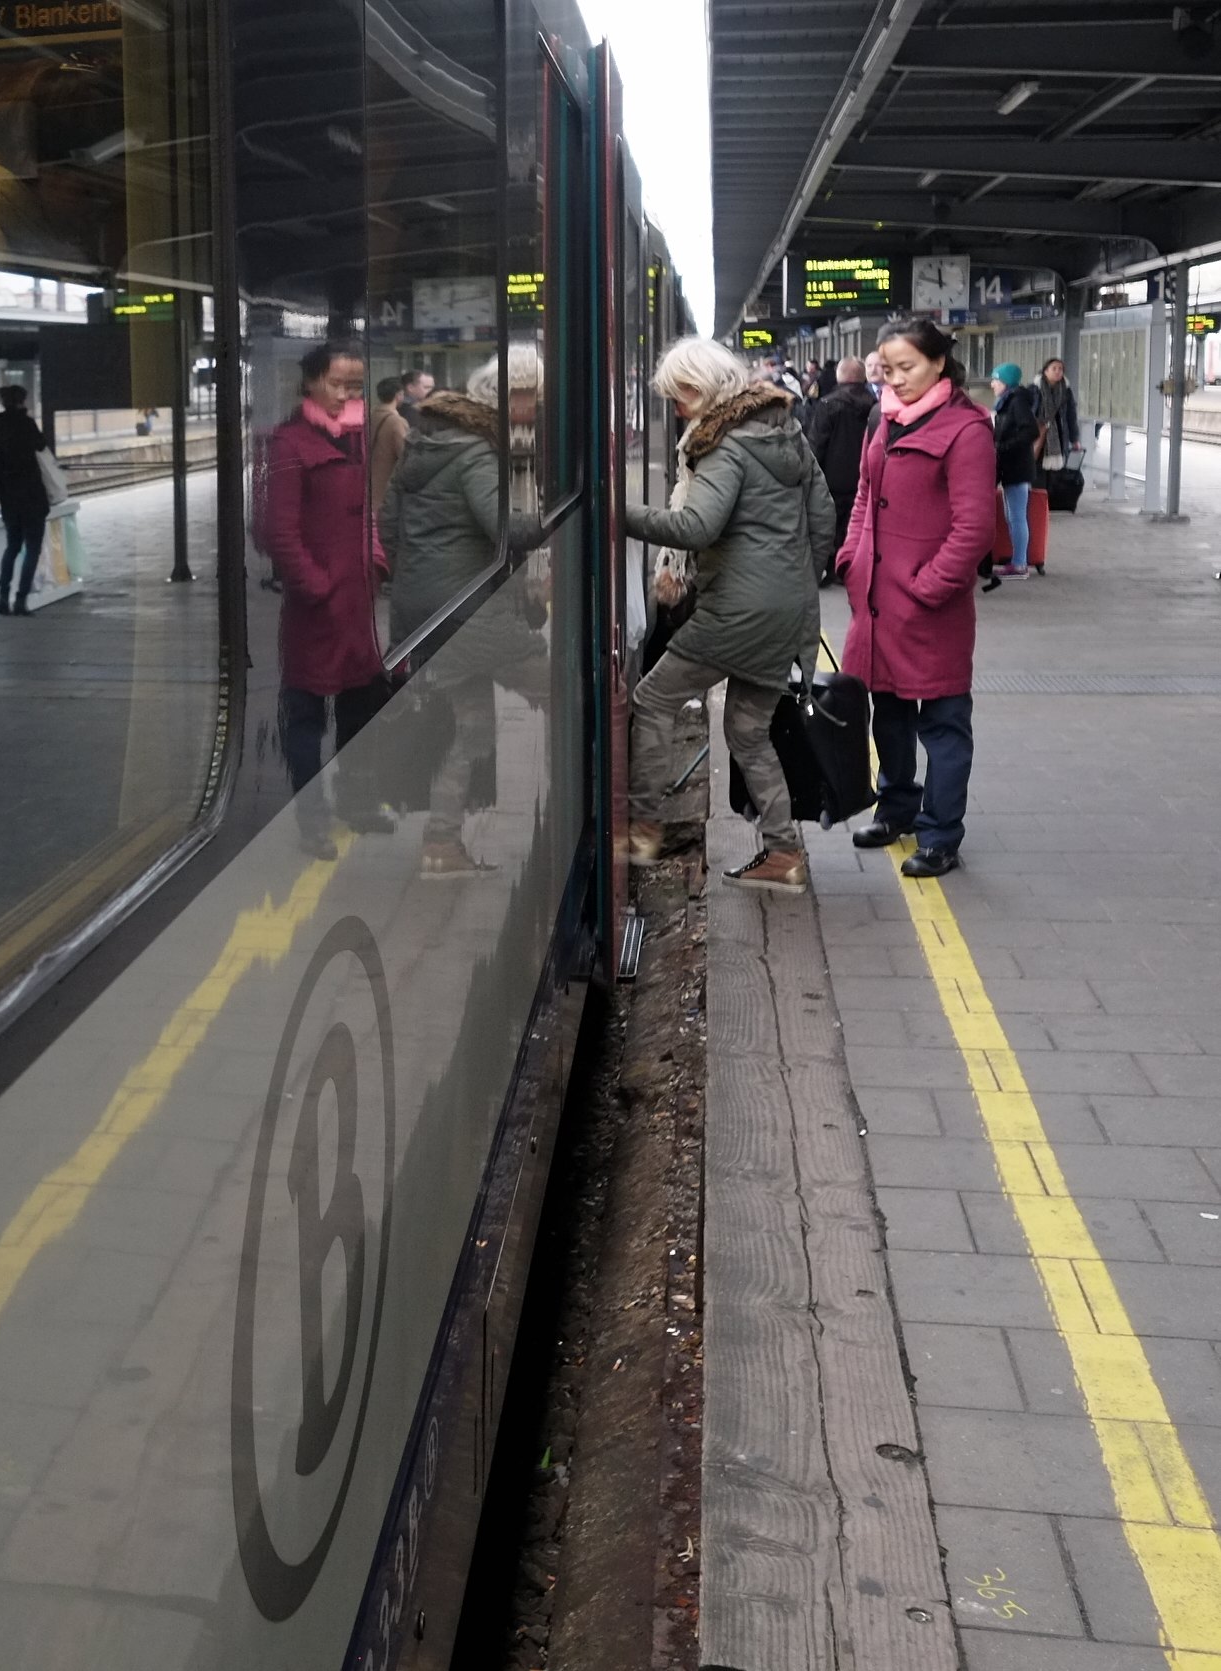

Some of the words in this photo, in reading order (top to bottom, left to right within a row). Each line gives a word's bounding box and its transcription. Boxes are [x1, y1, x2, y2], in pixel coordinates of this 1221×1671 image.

[975, 275, 1004, 306] 14
[287, 1022, 366, 1478] B
[963, 1567, 1028, 1620] 365
